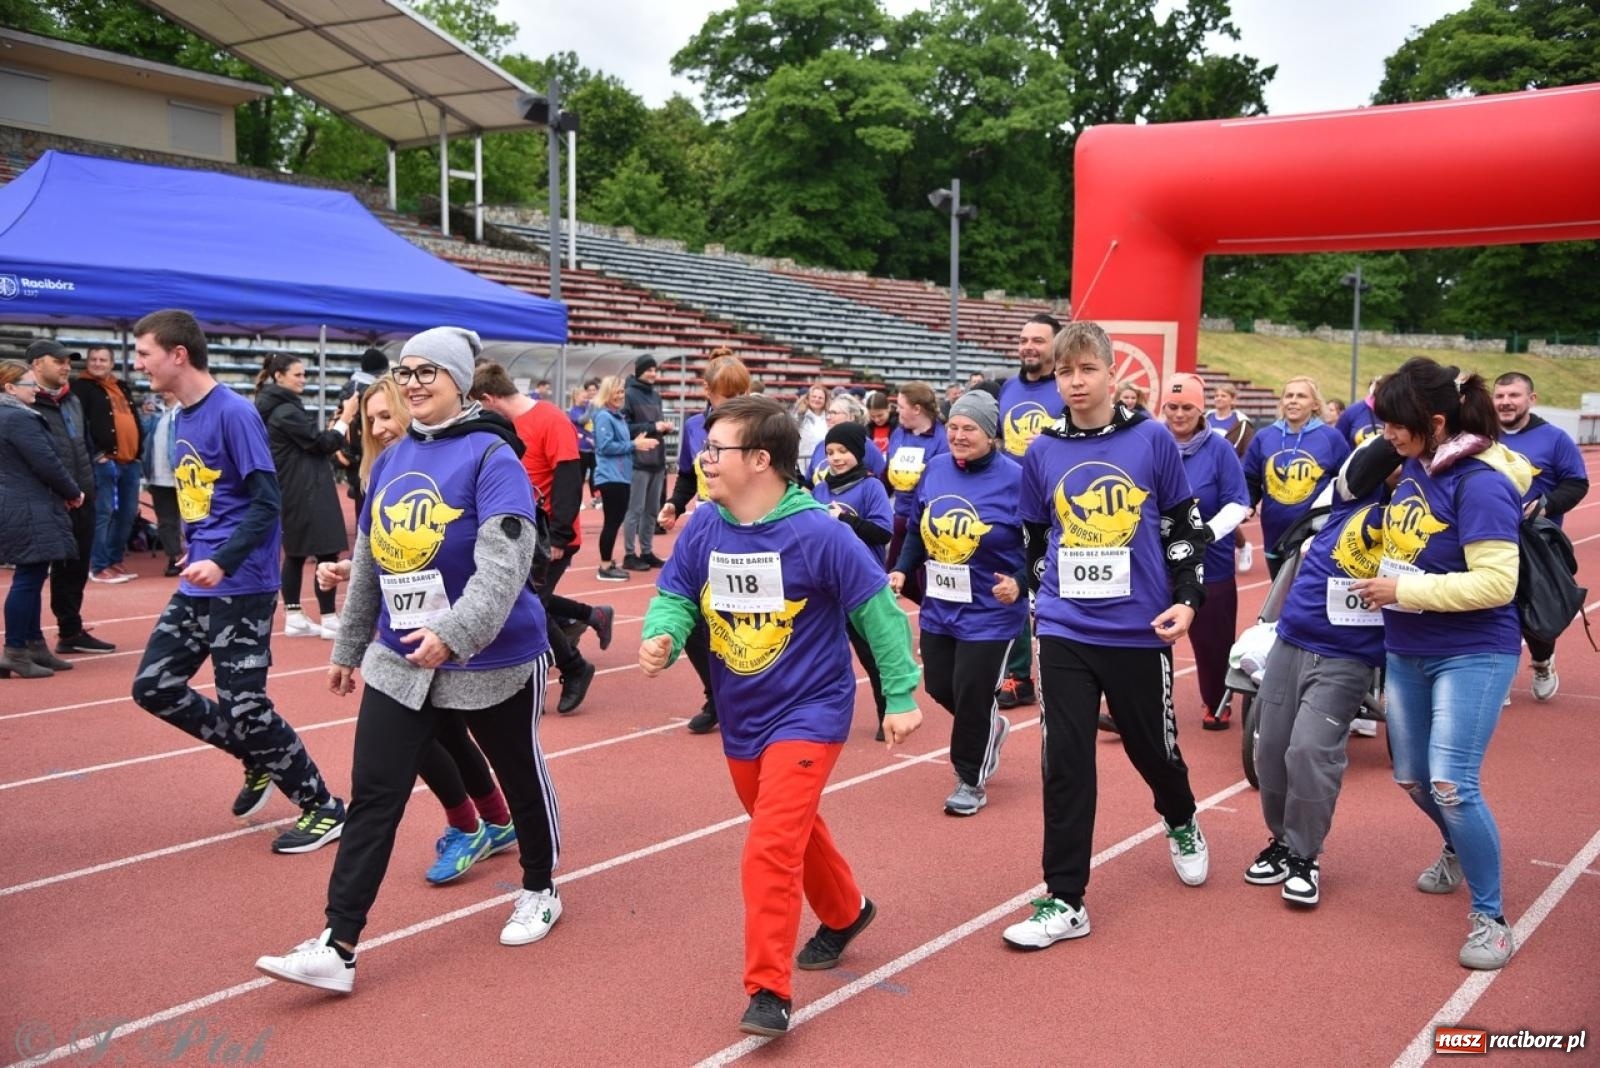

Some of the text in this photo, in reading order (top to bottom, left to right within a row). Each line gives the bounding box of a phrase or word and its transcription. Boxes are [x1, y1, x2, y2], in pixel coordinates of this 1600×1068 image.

[21, 278, 75, 290] Racibórz
[1095, 484, 1129, 516] 10
[403, 499, 432, 531] 10
[936, 574, 955, 589] 041
[1074, 565, 1113, 581] 085
[726, 574, 759, 594] 118
[394, 591, 426, 611] 077
